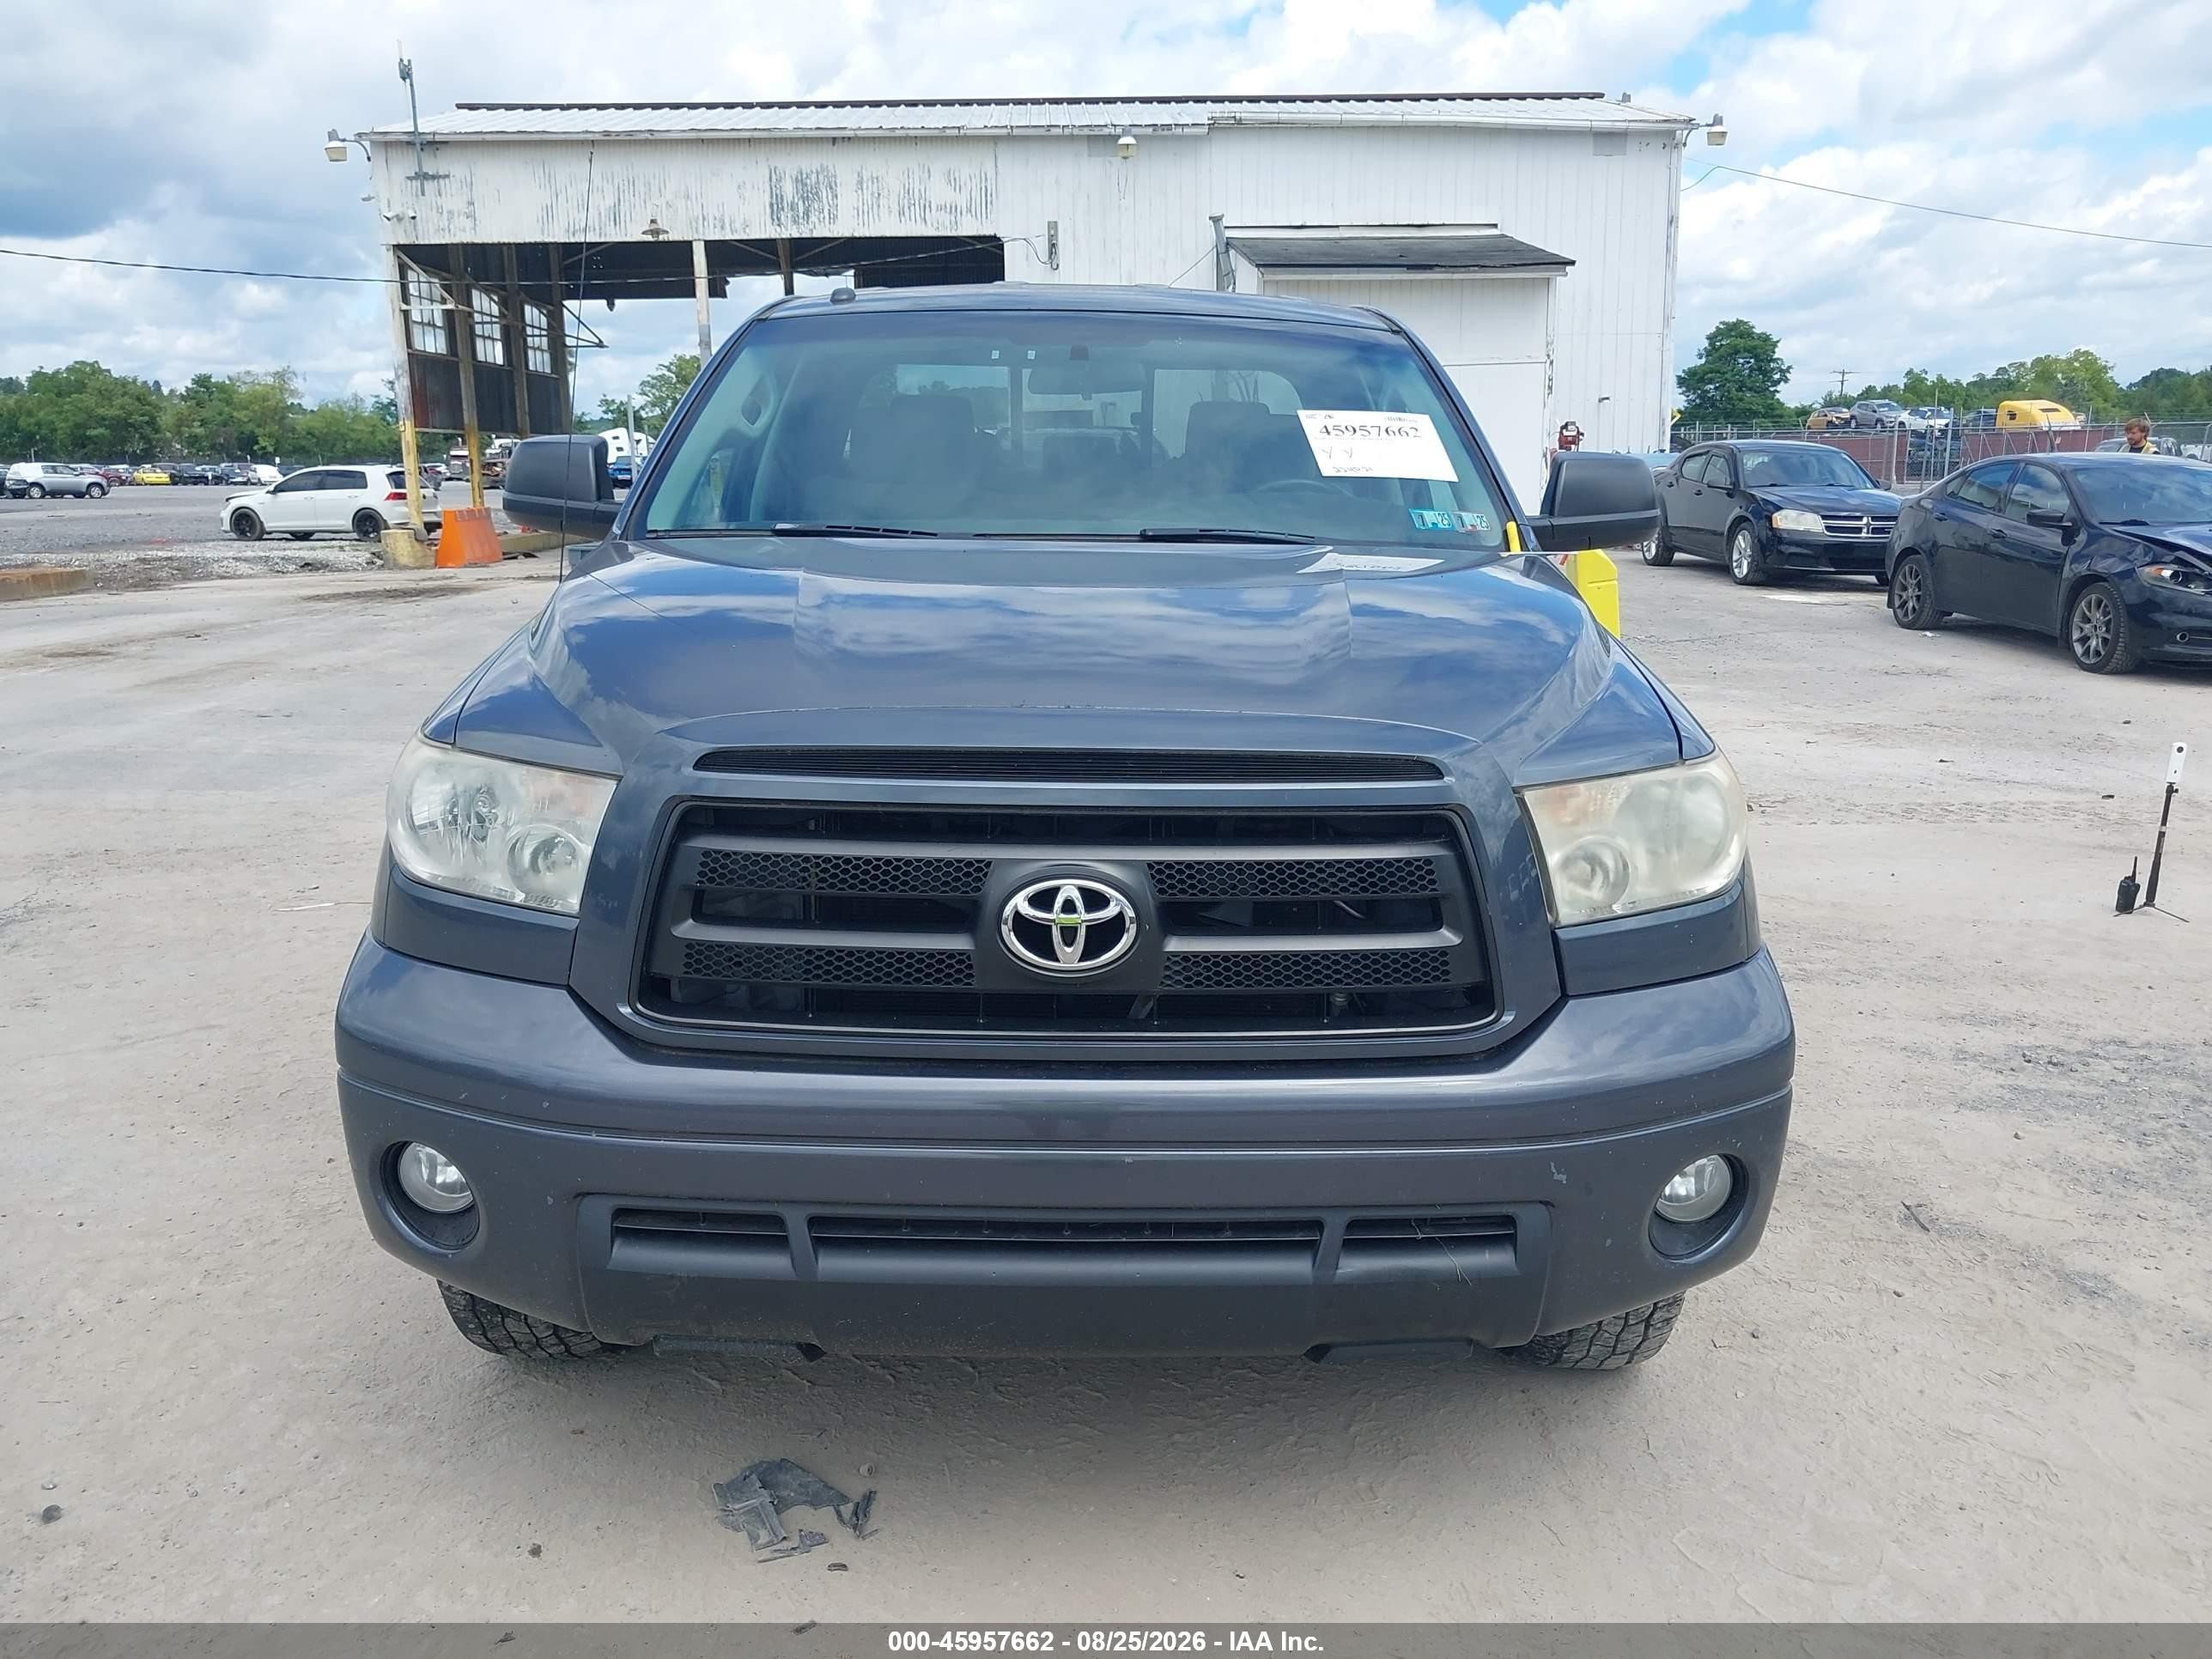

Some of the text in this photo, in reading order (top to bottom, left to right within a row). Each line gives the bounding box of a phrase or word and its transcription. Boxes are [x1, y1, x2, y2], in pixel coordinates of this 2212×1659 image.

[1319, 423, 1423, 439] 45957662
[1437, 512, 1451, 527] 25
[1476, 514, 1489, 529] 25
